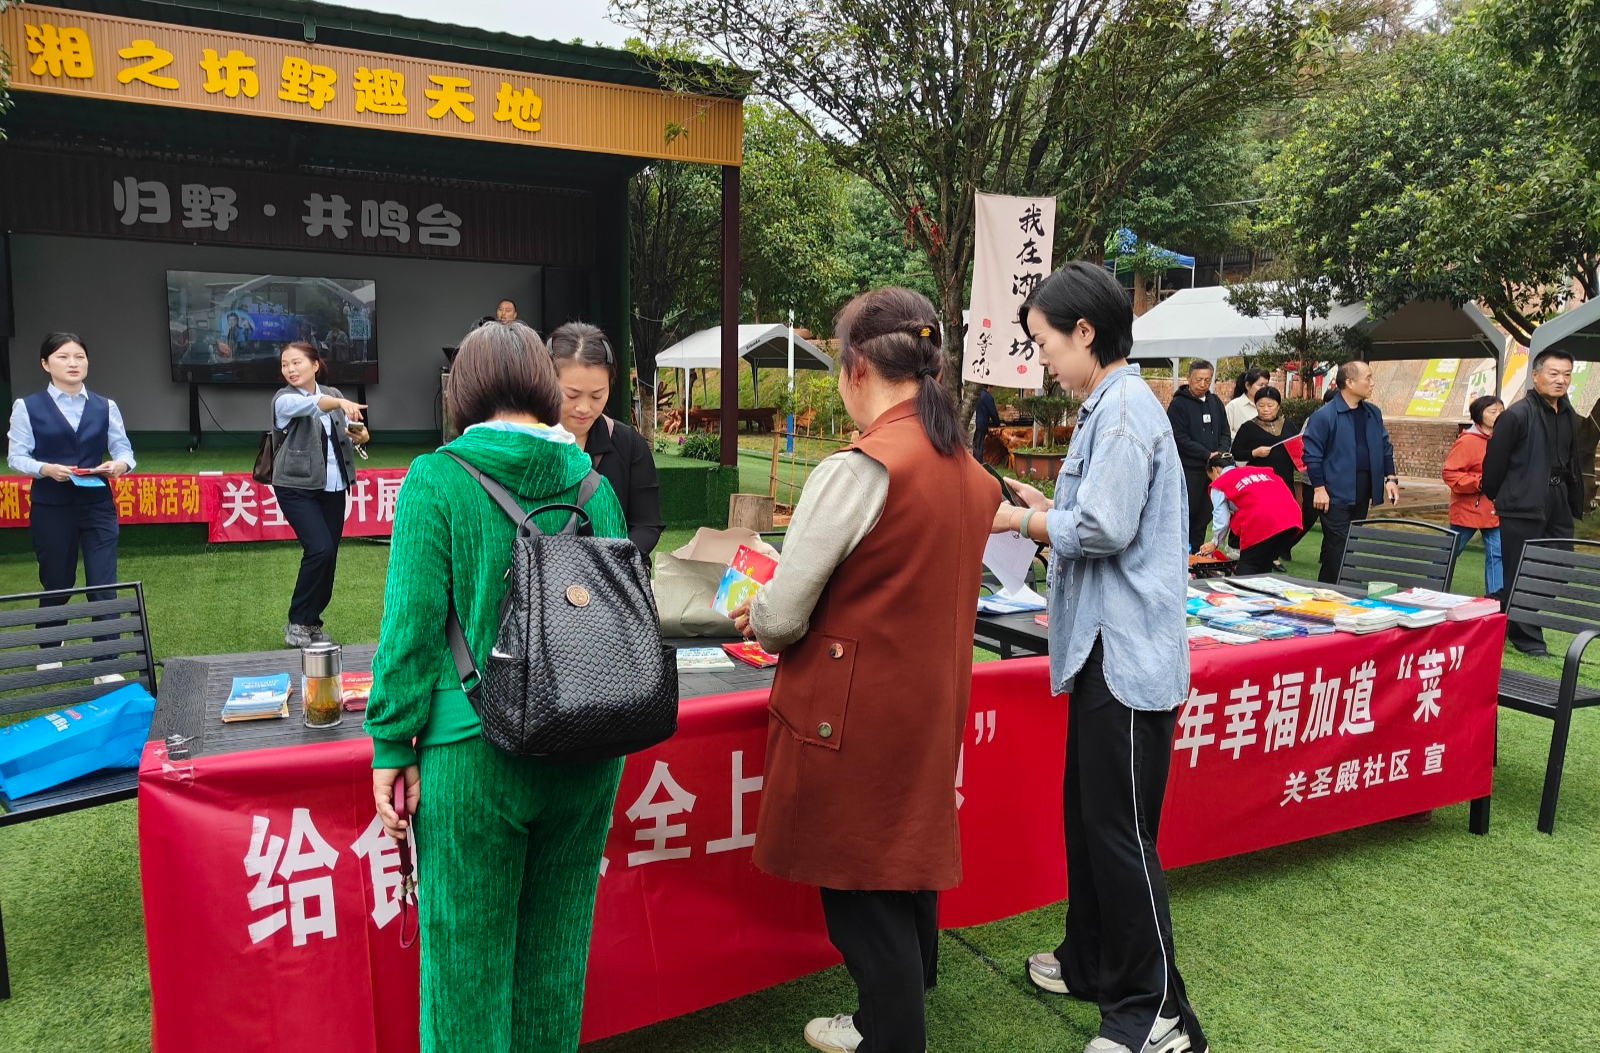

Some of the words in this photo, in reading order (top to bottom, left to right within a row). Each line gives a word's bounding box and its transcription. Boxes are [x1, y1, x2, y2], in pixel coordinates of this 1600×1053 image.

[24, 23, 544, 132] 湘之坊野趣天地
[1009, 203, 1045, 361] 我在湘坊
[1280, 749, 1410, 807] 关圣殿社区
[1422, 743, 1446, 775] 宣
